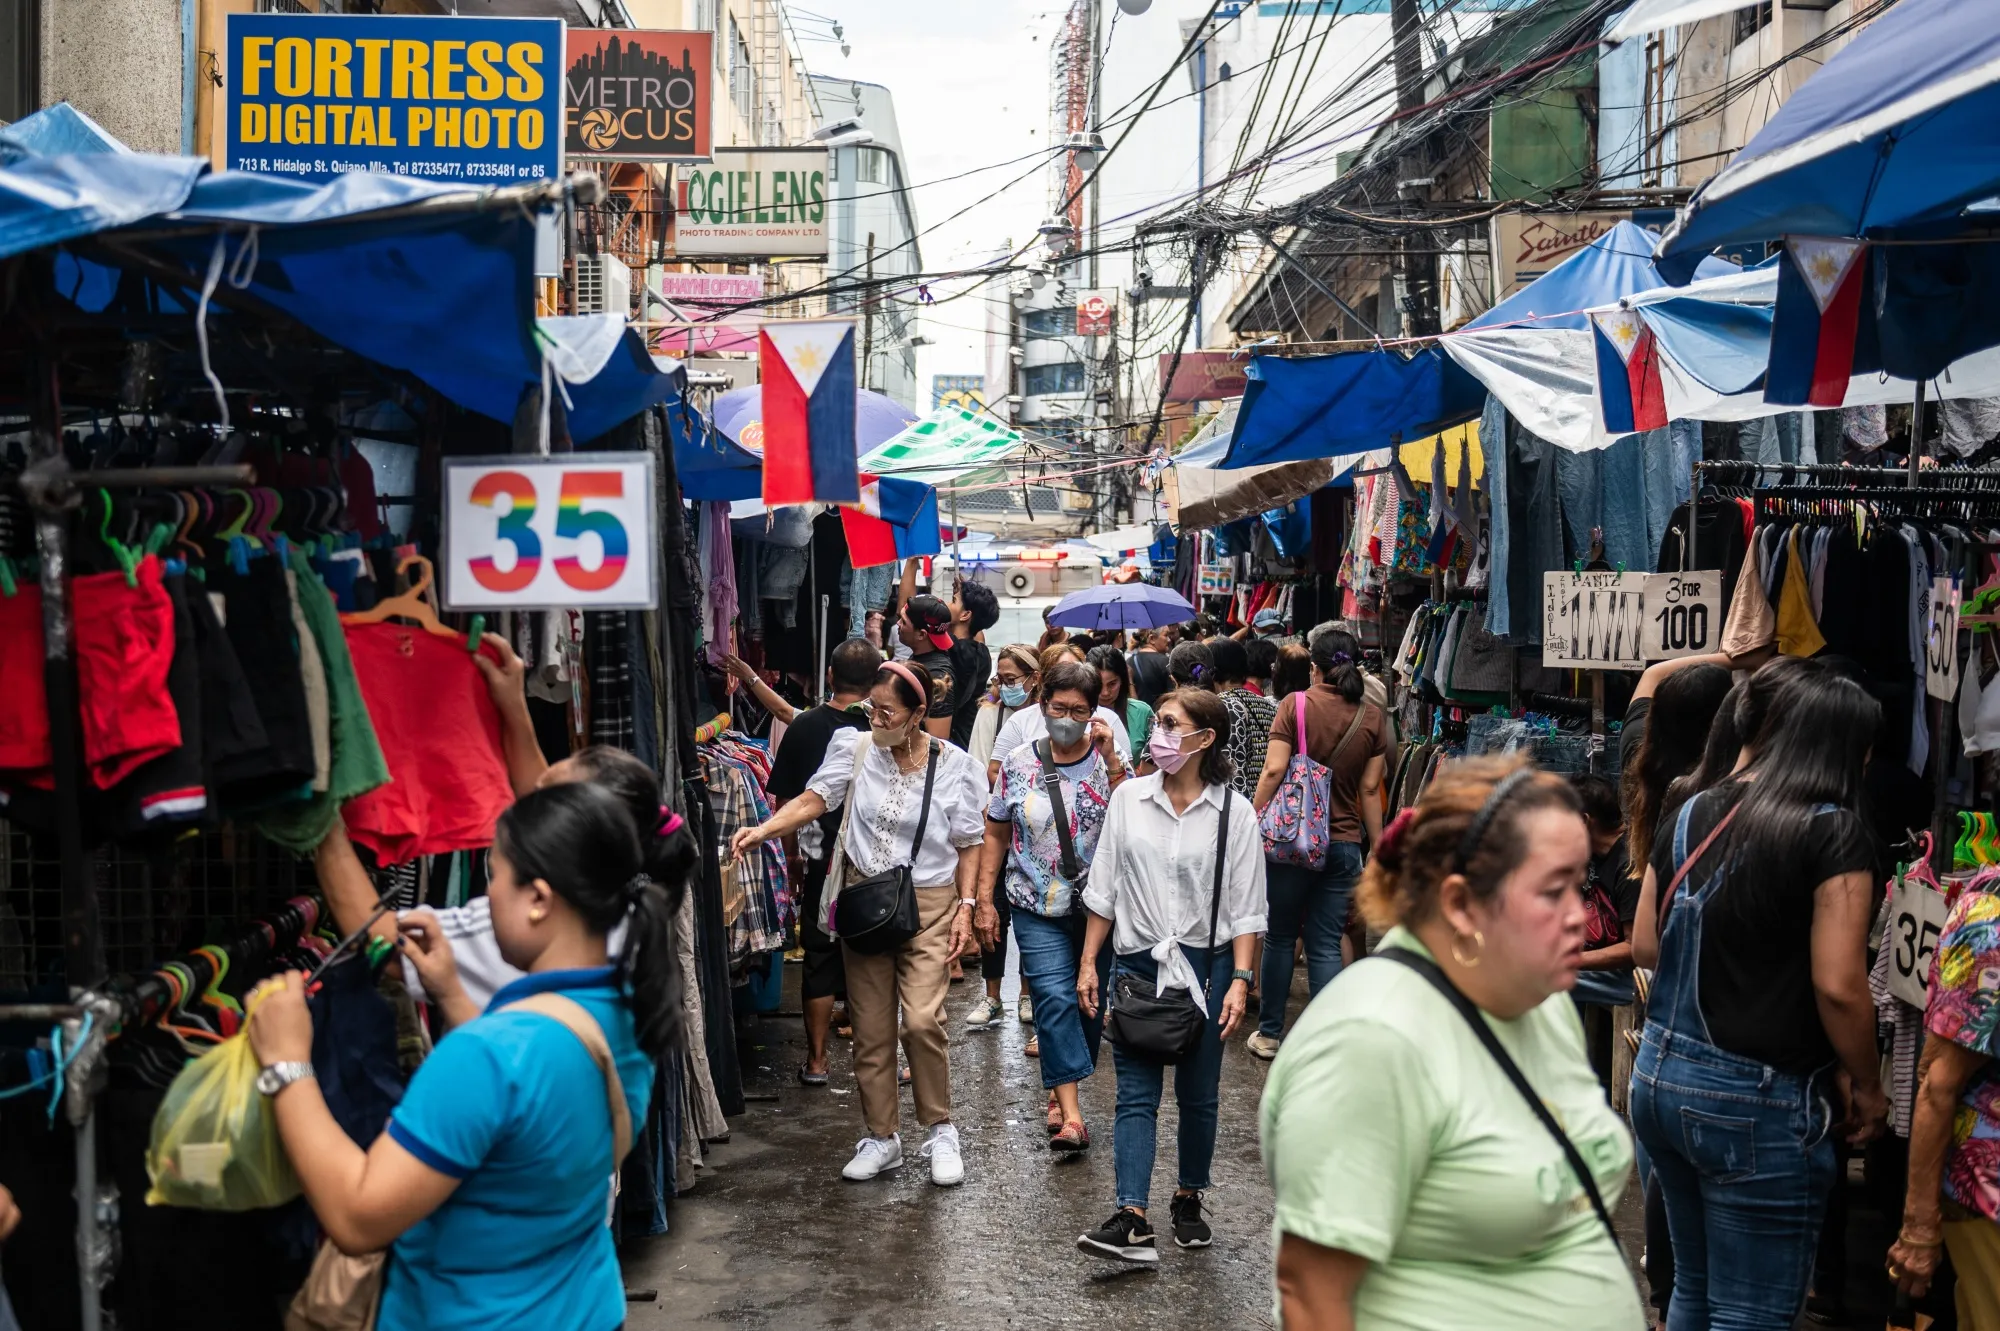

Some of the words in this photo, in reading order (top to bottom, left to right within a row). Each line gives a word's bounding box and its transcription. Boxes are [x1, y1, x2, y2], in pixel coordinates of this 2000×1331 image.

[242, 36, 544, 102] FORTRESS
[566, 76, 694, 109] METRO
[240, 103, 397, 147] DIGITAL
[408, 106, 544, 150] PHOTO
[238, 158, 257, 171] 713
[260, 159, 270, 171] R.
[273, 159, 311, 175] Hidalgo
[314, 160, 328, 172] St.
[393, 162, 408, 175] Tel
[411, 162, 464, 178] 87335477,
[466, 163, 515, 177] 87335481
[518, 167, 529, 177] or
[532, 165, 545, 178] 85
[680, 229, 711, 237] PHOTO
[756, 229, 801, 237] COMPANY
[662, 277, 709, 295] SHAYNE
[711, 279, 761, 296] OPTICAL
[468, 470, 629, 593] 35
[1200, 572, 1232, 593] 50
[1665, 577, 1681, 603] 3
[1682, 582, 1701, 597] FOR
[1655, 603, 1708, 651] 100
[1931, 601, 1954, 677] 50
[1895, 911, 1942, 991] 35
